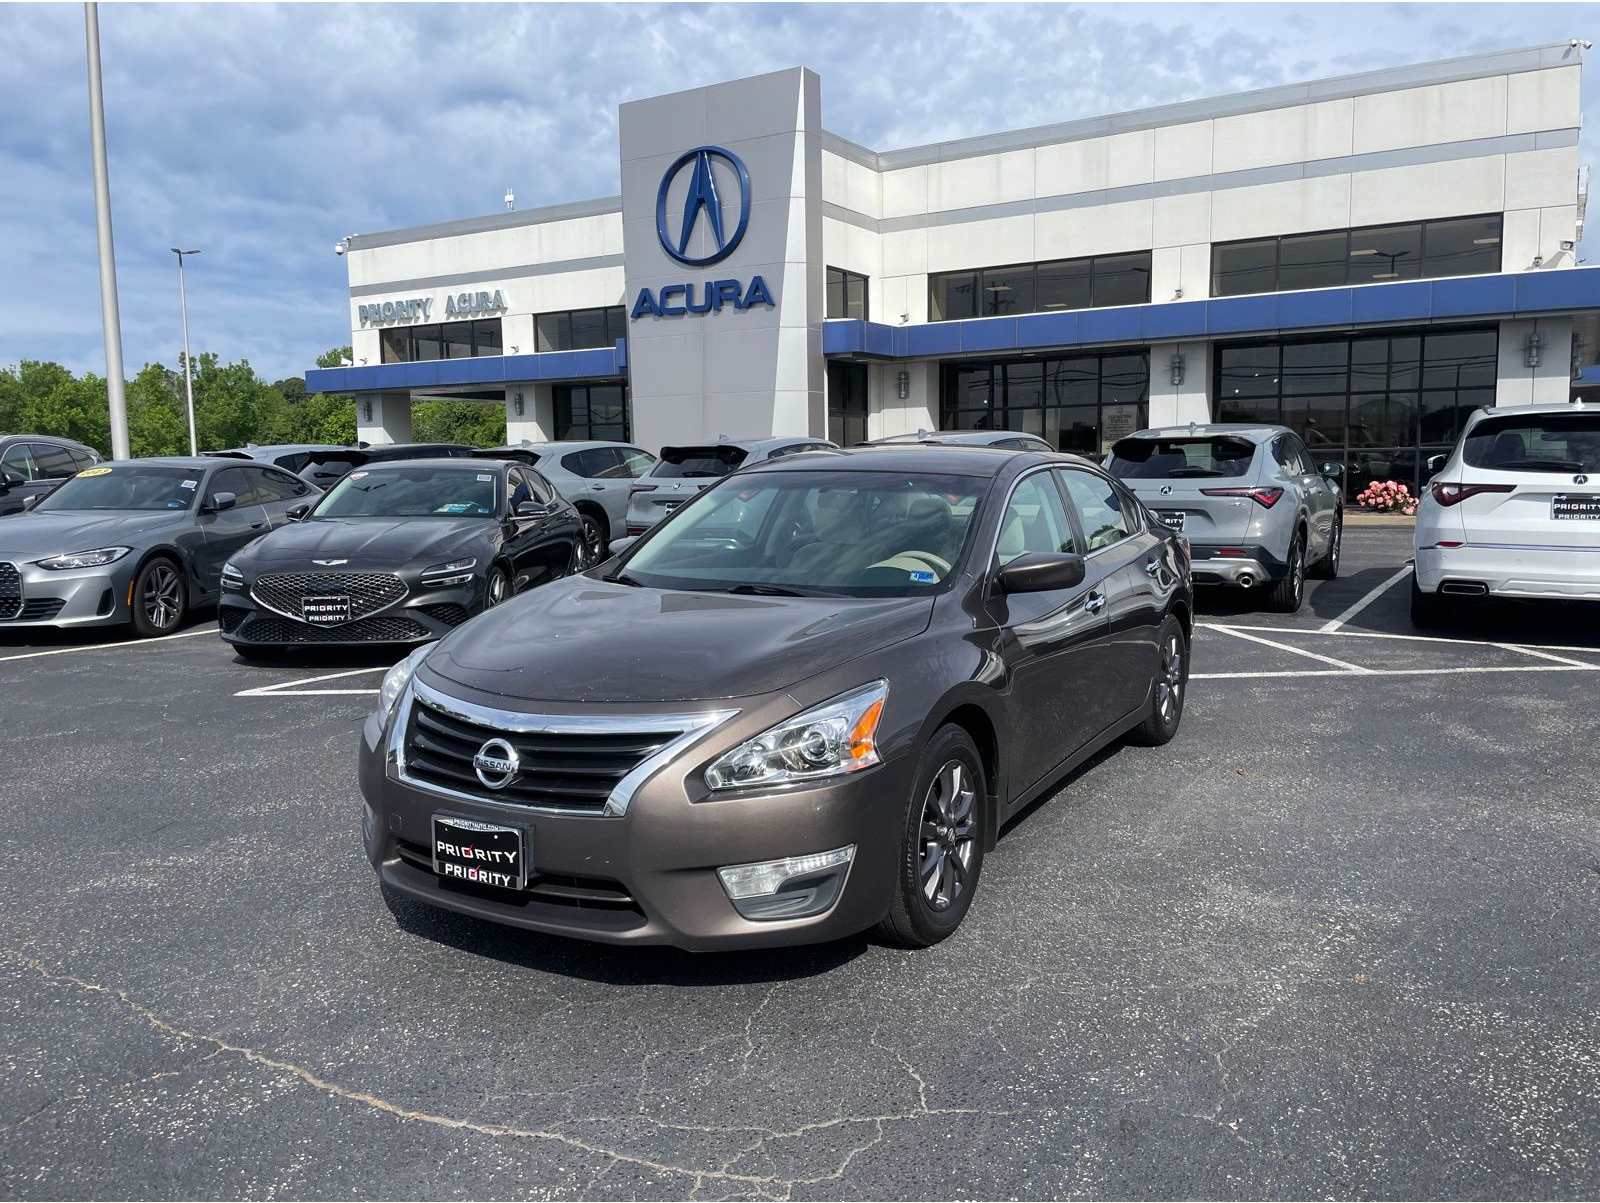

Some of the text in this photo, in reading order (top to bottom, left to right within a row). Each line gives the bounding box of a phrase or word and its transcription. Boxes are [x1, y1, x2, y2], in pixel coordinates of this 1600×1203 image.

[358, 289, 505, 324] PRIORITY ACURA
[630, 275, 776, 318] ACURA
[437, 841, 517, 864] PRIORITY
[445, 863, 511, 887] PRIORITY
